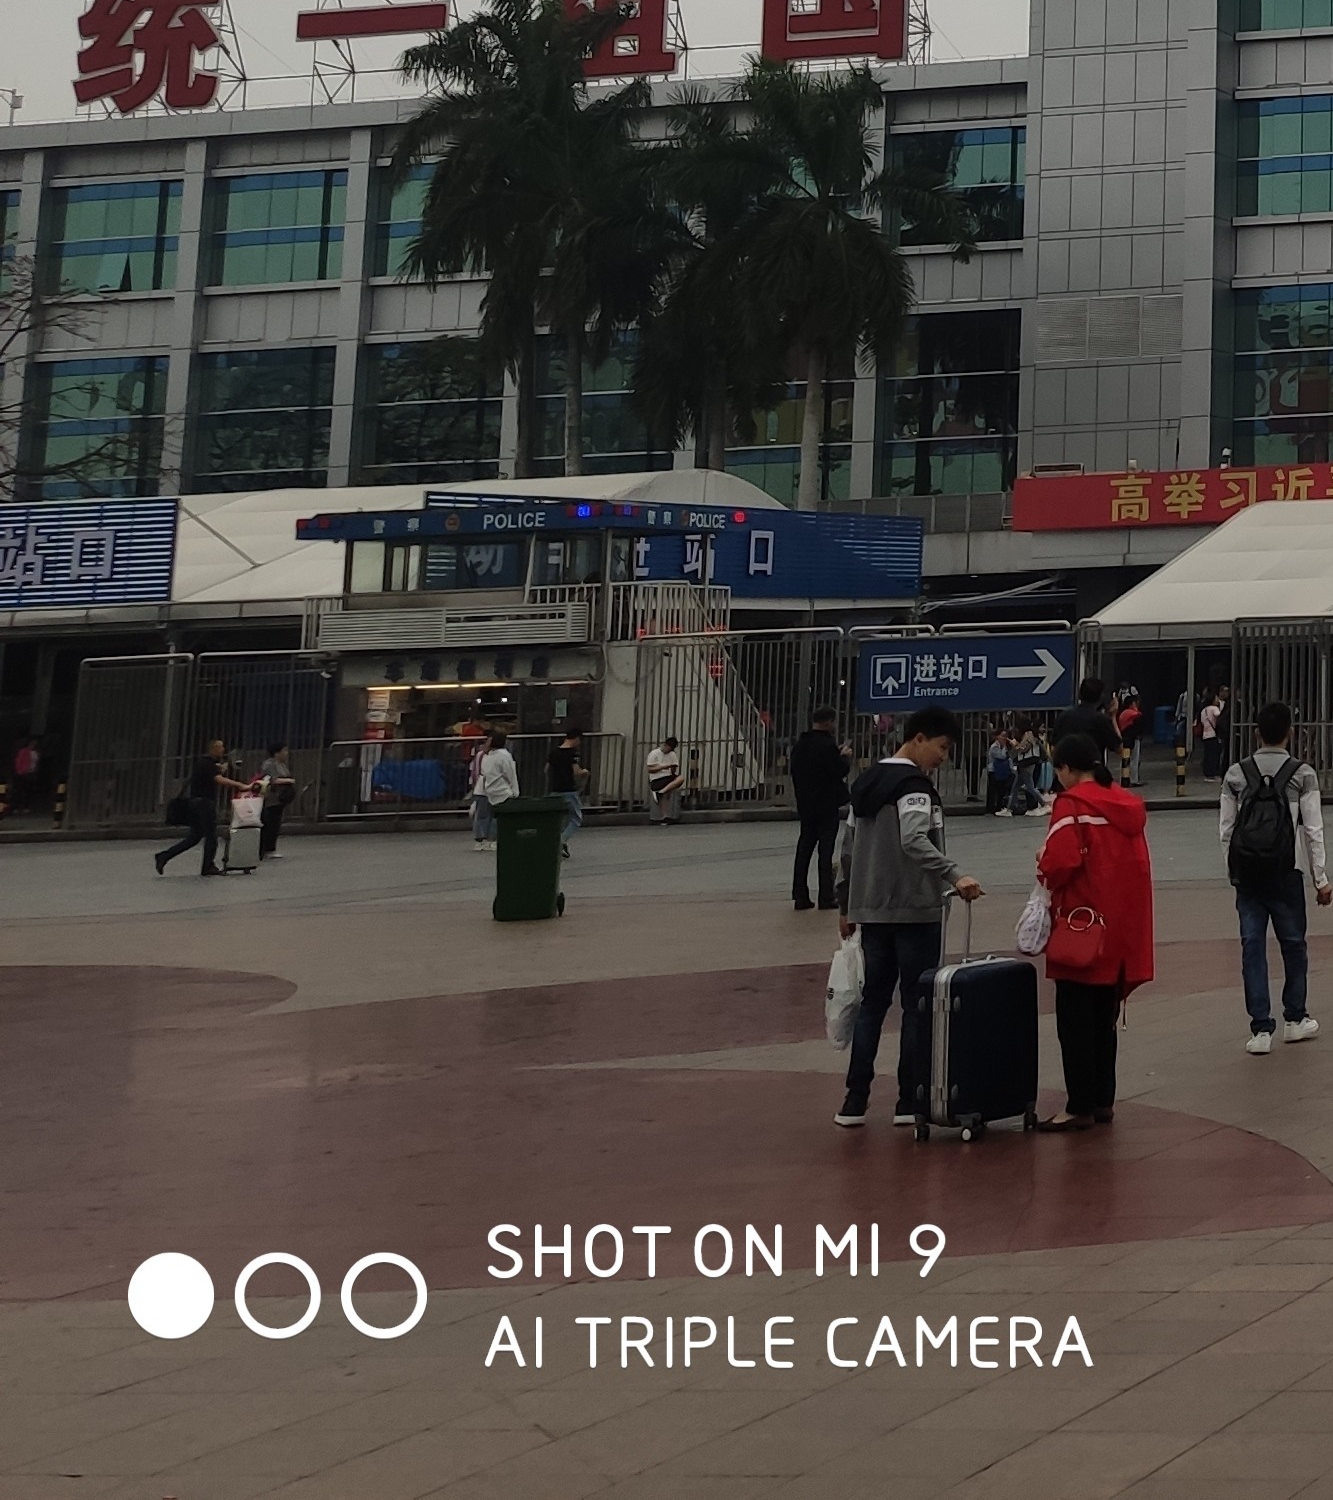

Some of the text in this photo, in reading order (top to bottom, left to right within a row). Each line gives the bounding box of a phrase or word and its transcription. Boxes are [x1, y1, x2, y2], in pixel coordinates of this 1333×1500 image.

[483, 512, 546, 530] POLICE
[689, 512, 726, 529] POLICE
[913, 653, 988, 683] 进站口
[913, 686, 960, 697] Entrance
